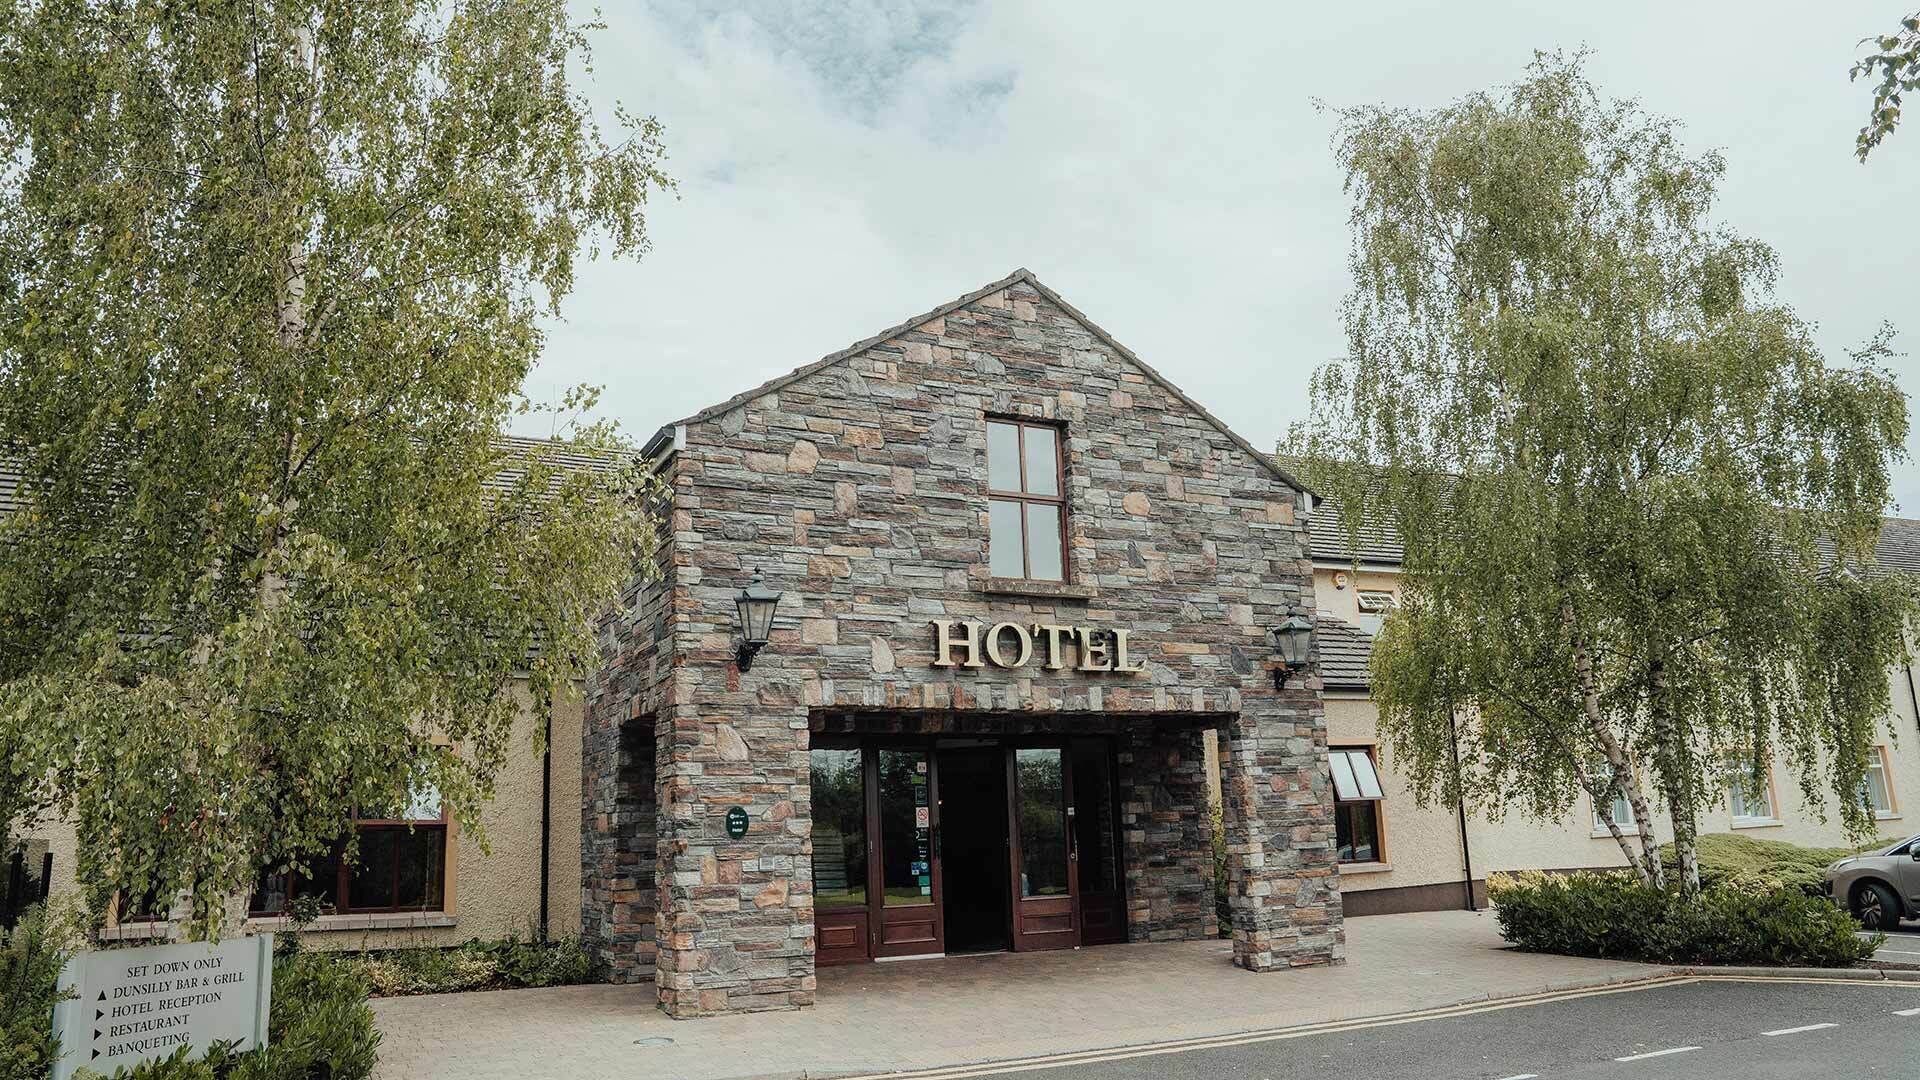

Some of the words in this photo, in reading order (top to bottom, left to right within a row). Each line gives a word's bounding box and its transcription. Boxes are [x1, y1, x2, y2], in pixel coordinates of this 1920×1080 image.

[931, 619, 1147, 672] HOTEL
[127, 966, 149, 978] SET
[154, 961, 190, 975] DOWN
[194, 957, 224, 970] ONLY
[113, 981, 172, 999] DUNSILLY
[176, 977, 198, 989] BAR
[202, 977, 209, 986] &
[214, 972, 245, 984] GRILL
[111, 1002, 153, 1018] HOTEL
[158, 991, 222, 1011] RECEPTION
[109, 1014, 190, 1038] RESTAURANT
[108, 1032, 190, 1057] BANQUETING
